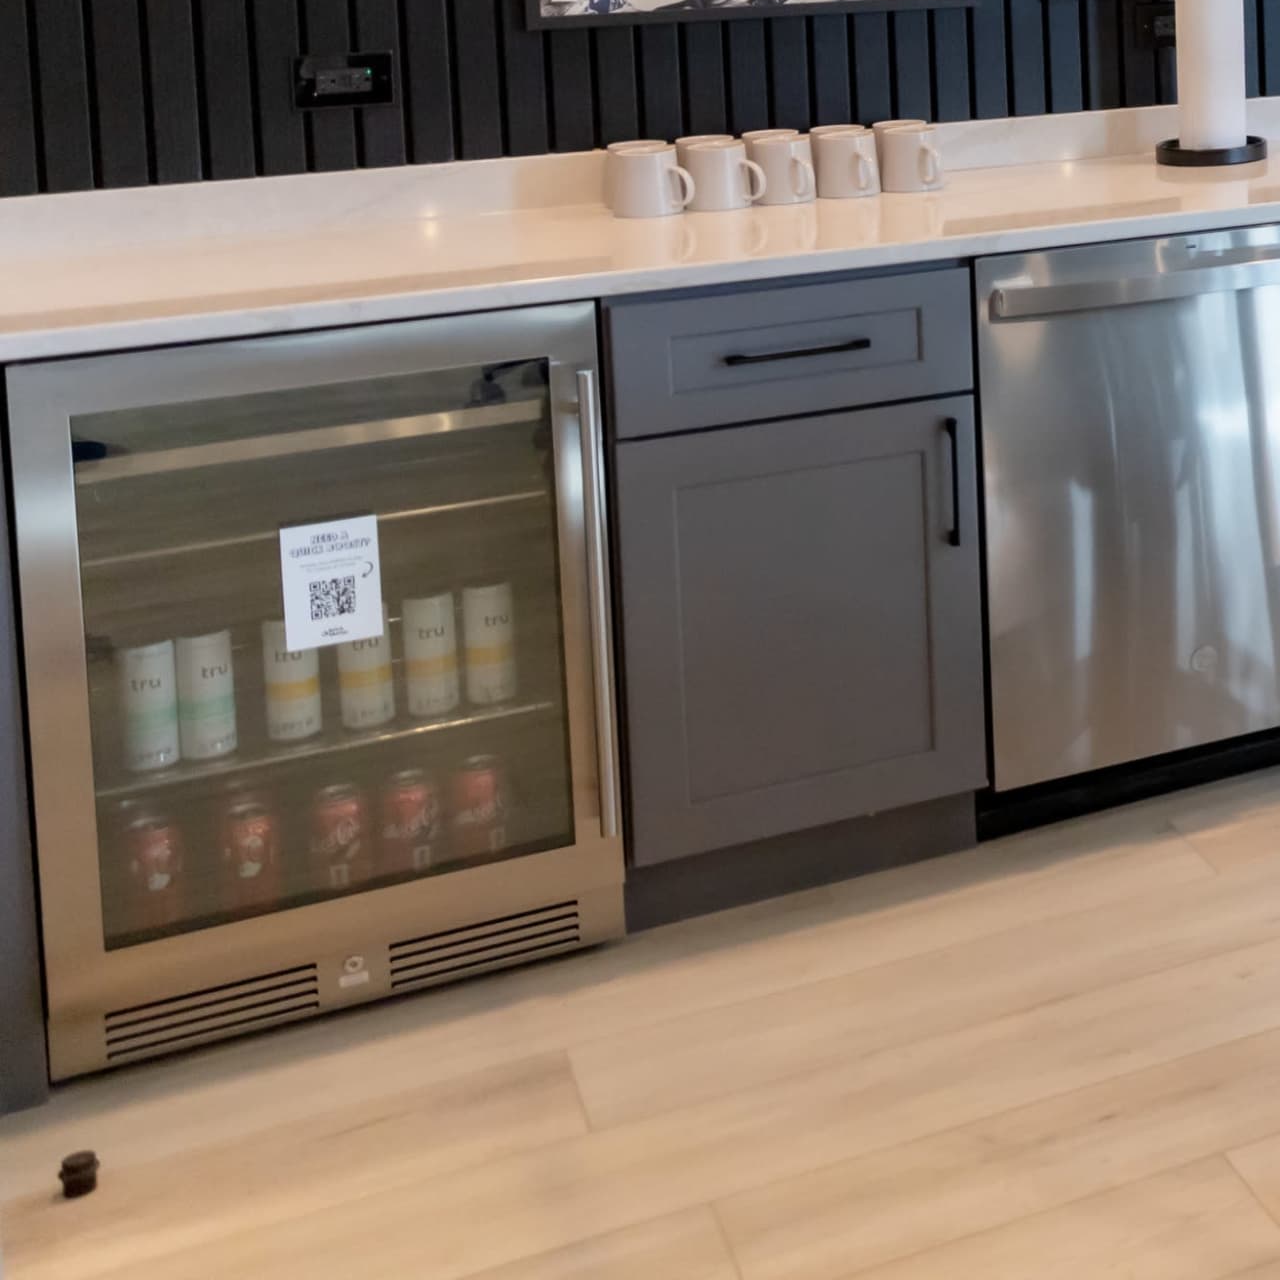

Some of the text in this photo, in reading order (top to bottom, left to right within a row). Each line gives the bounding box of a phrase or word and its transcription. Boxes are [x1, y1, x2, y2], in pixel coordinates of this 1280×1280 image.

[485, 614, 510, 628] tru
[418, 625, 446, 640] tru
[200, 663, 229, 679] tru
[130, 677, 162, 692] tru
